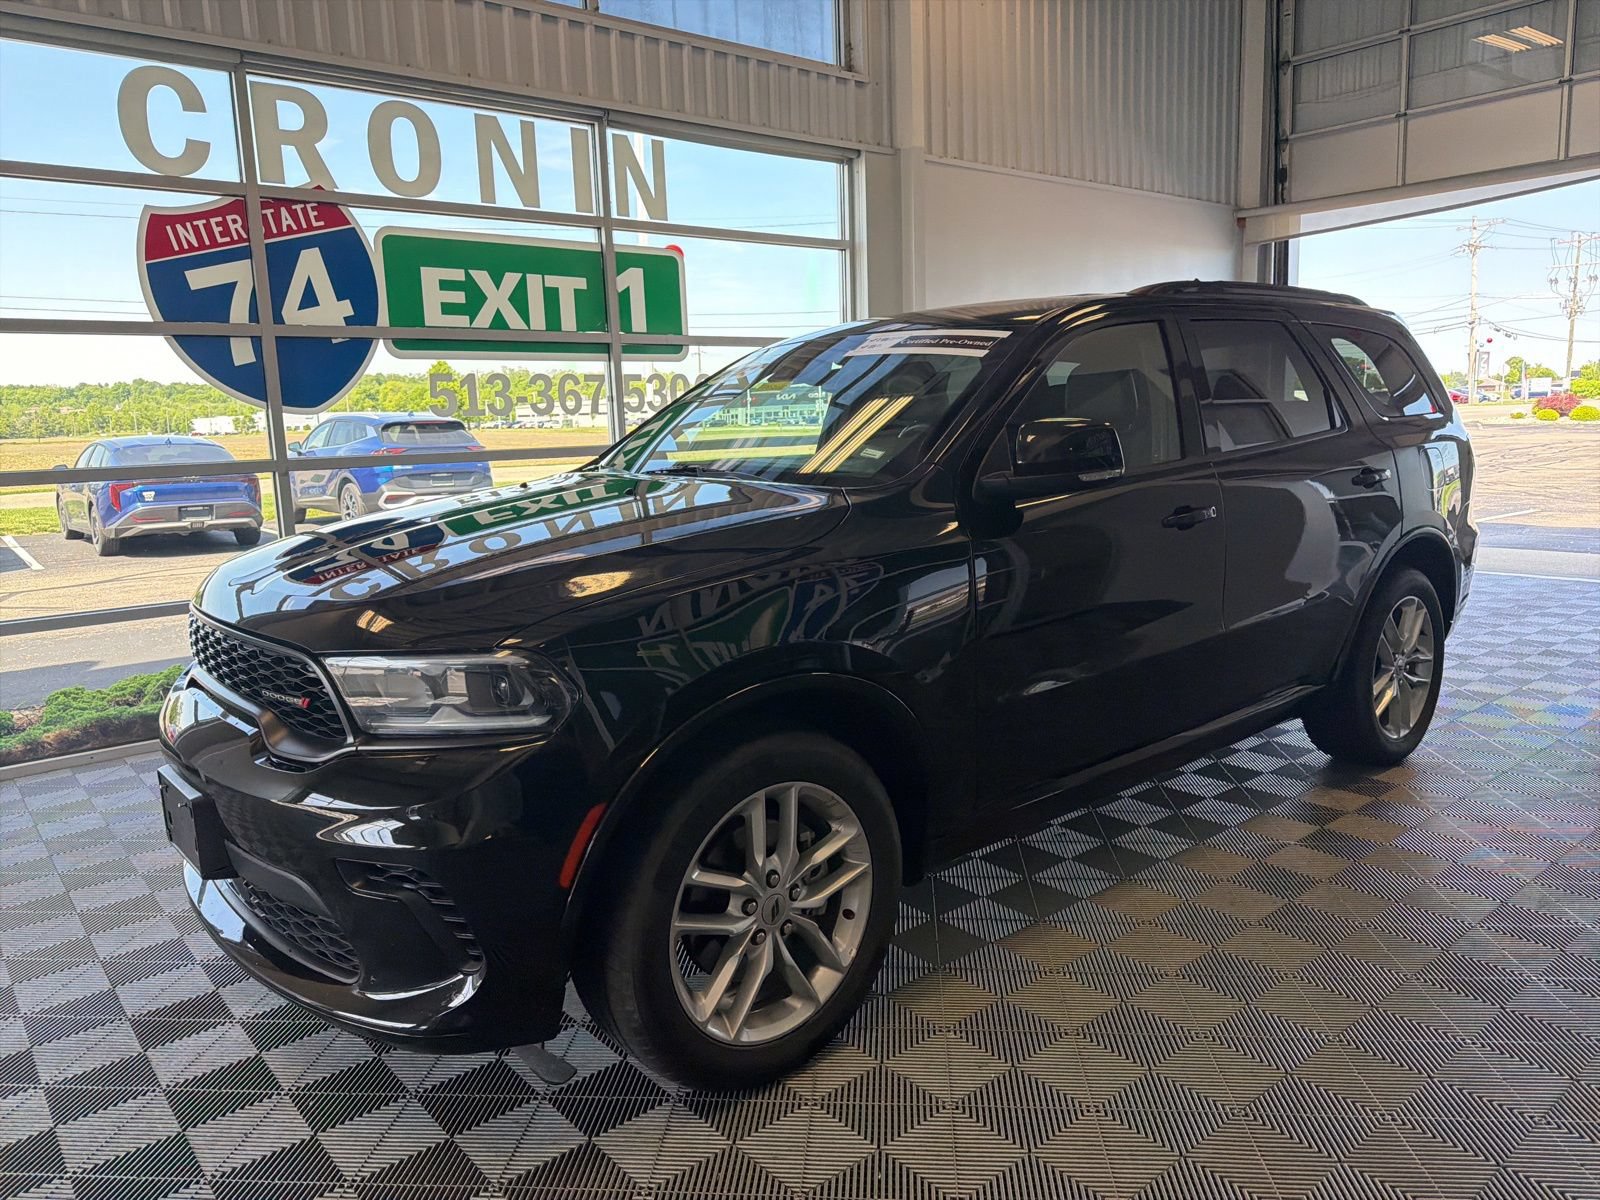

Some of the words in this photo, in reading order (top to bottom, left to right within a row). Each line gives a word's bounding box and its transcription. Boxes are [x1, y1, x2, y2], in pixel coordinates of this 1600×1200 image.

[116, 64, 668, 221] CRONIN
[165, 202, 325, 251] INTERTATE
[184, 246, 355, 367] 74
[420, 266, 587, 332] EXIT
[615, 267, 648, 333] 1
[900, 338, 940, 346] Certified
[940, 338, 993, 348] Pre-Owned
[428, 373, 710, 417] 513-367530
